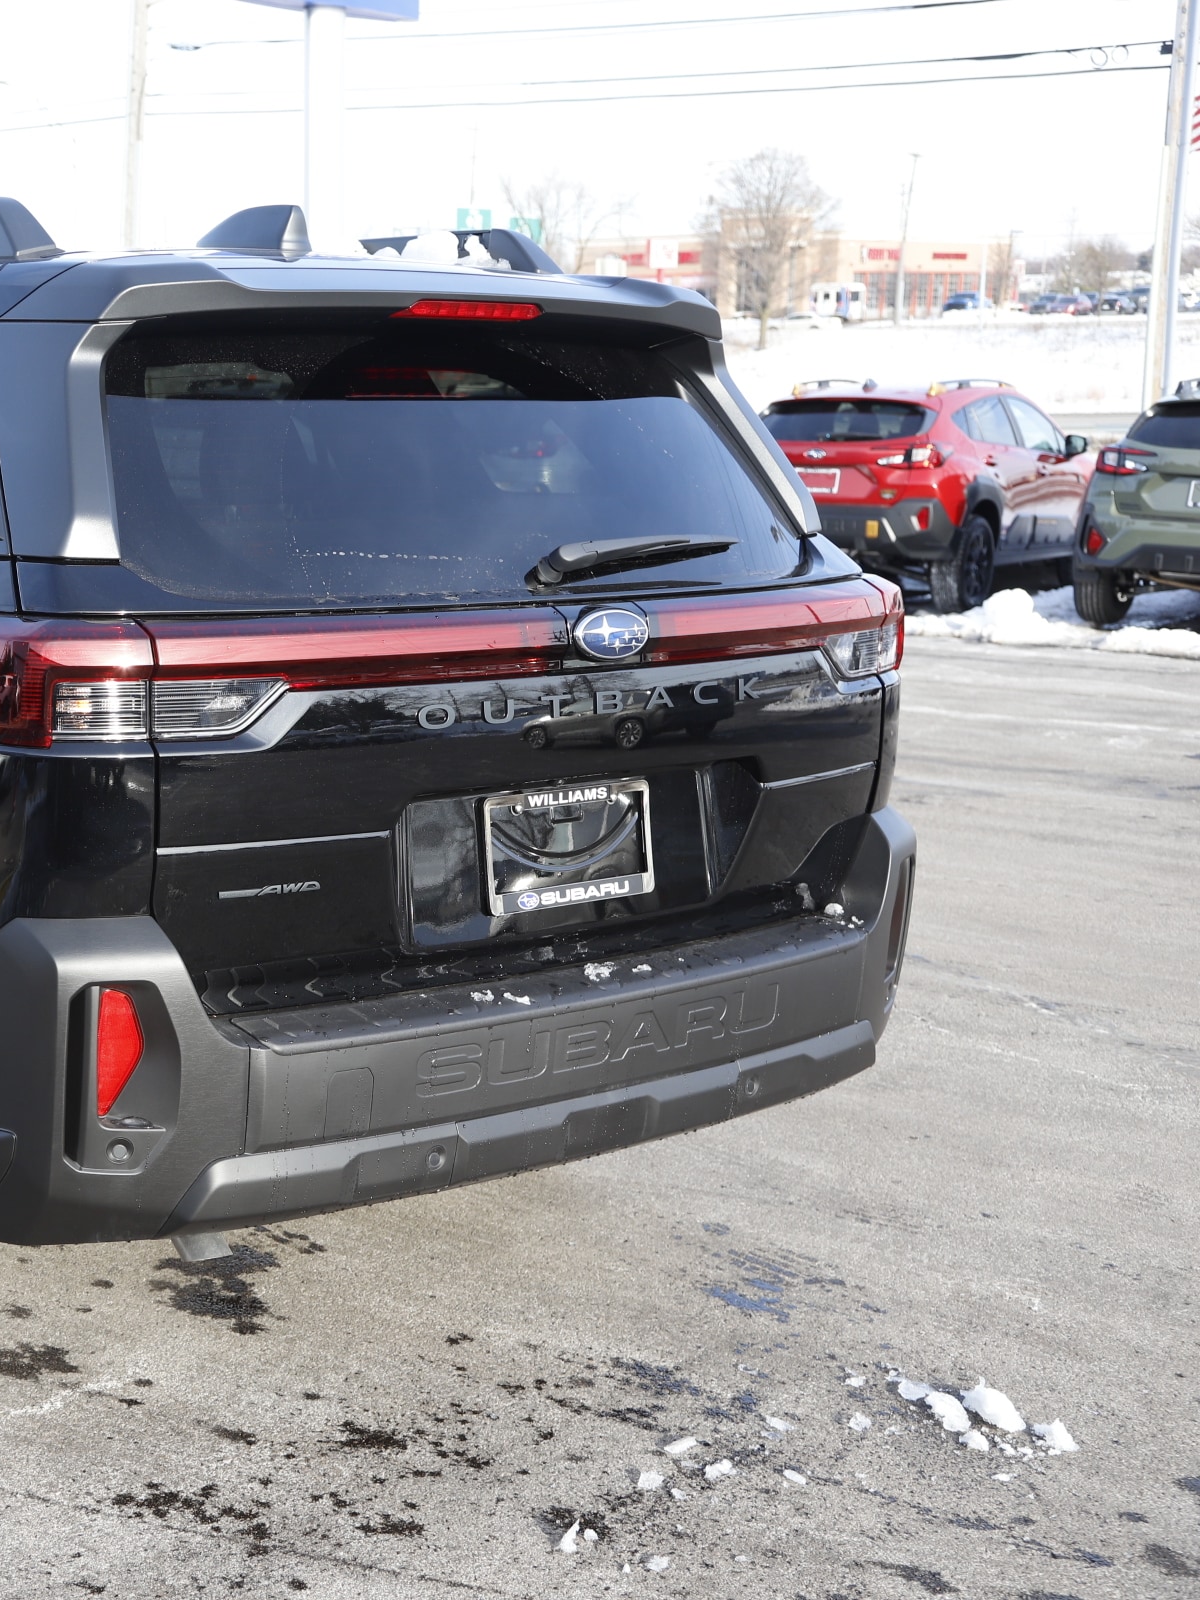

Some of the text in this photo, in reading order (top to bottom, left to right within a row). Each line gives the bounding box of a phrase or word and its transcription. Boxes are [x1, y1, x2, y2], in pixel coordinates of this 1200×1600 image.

[418, 677, 761, 730] OUTBACK
[528, 787, 608, 807] WILLIAMS
[258, 881, 320, 896] AWD
[540, 880, 630, 905] SUBARU
[415, 983, 780, 1098] SUBARU
